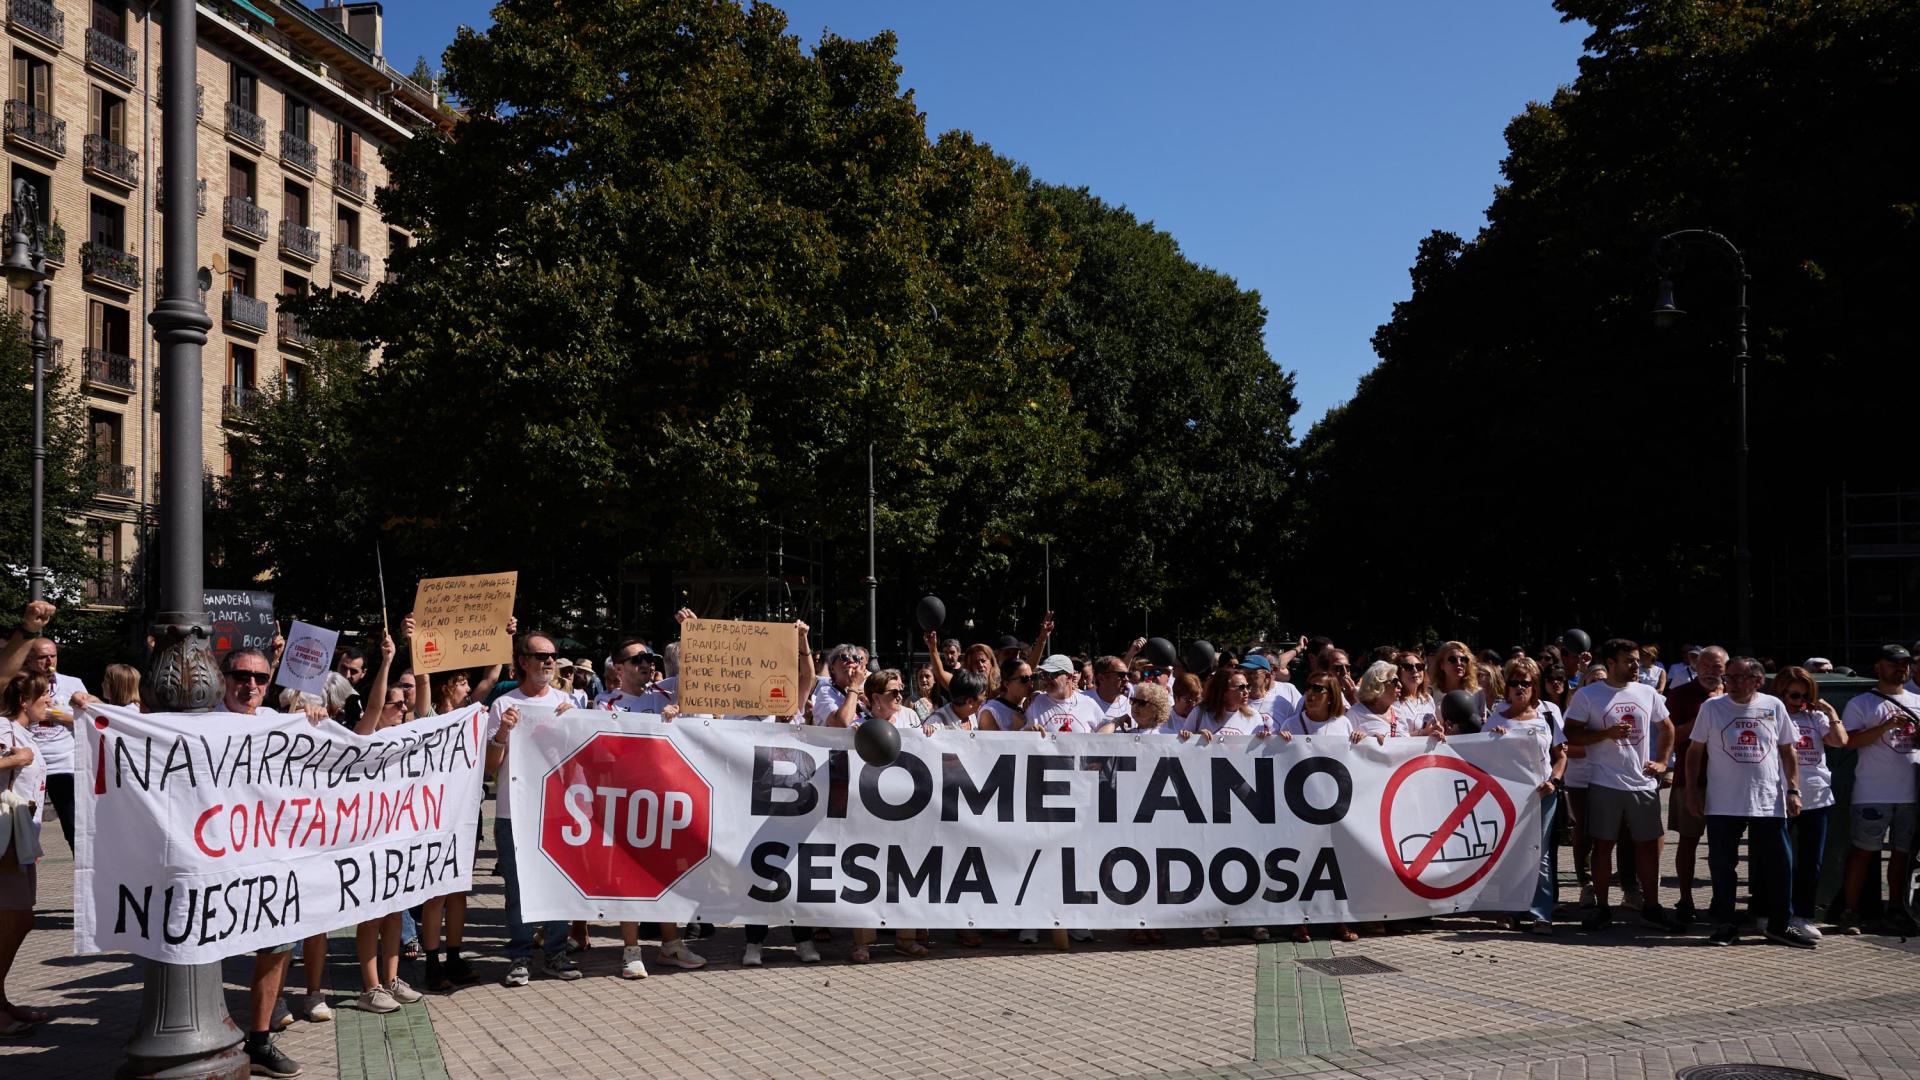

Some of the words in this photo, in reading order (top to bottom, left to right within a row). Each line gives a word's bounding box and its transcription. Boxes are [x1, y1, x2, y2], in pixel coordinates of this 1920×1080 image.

[203, 592, 252, 606] GANADERÍA
[260, 612, 274, 626] DE
[437, 616, 450, 626] NO
[454, 625, 498, 640] POBLACIÓN
[686, 622, 706, 632] UNA
[710, 623, 768, 637] VERDADERA
[243, 631, 276, 650] BIOGÁ
[686, 637, 747, 652] TRANSICIÓN
[462, 643, 490, 654] RURAL
[684, 652, 753, 667] ENERGÉTICA
[760, 659, 778, 670] NO
[686, 667, 714, 677] PUEDE
[720, 668, 755, 679] PONER
[686, 681, 699, 690] EN
[704, 682, 741, 693] RIESGO
[684, 697, 730, 708] NUESTROS
[750, 745, 1353, 825] BIOMETANO
[194, 783, 444, 858] CONTAMINAN
[561, 784, 693, 850] STOP
[748, 841, 998, 904] SESMA
[1014, 849, 1042, 906] /
[1062, 847, 1348, 905] LODOSA
[114, 870, 300, 946] NUESTRA
[335, 833, 459, 912] RIBERA
